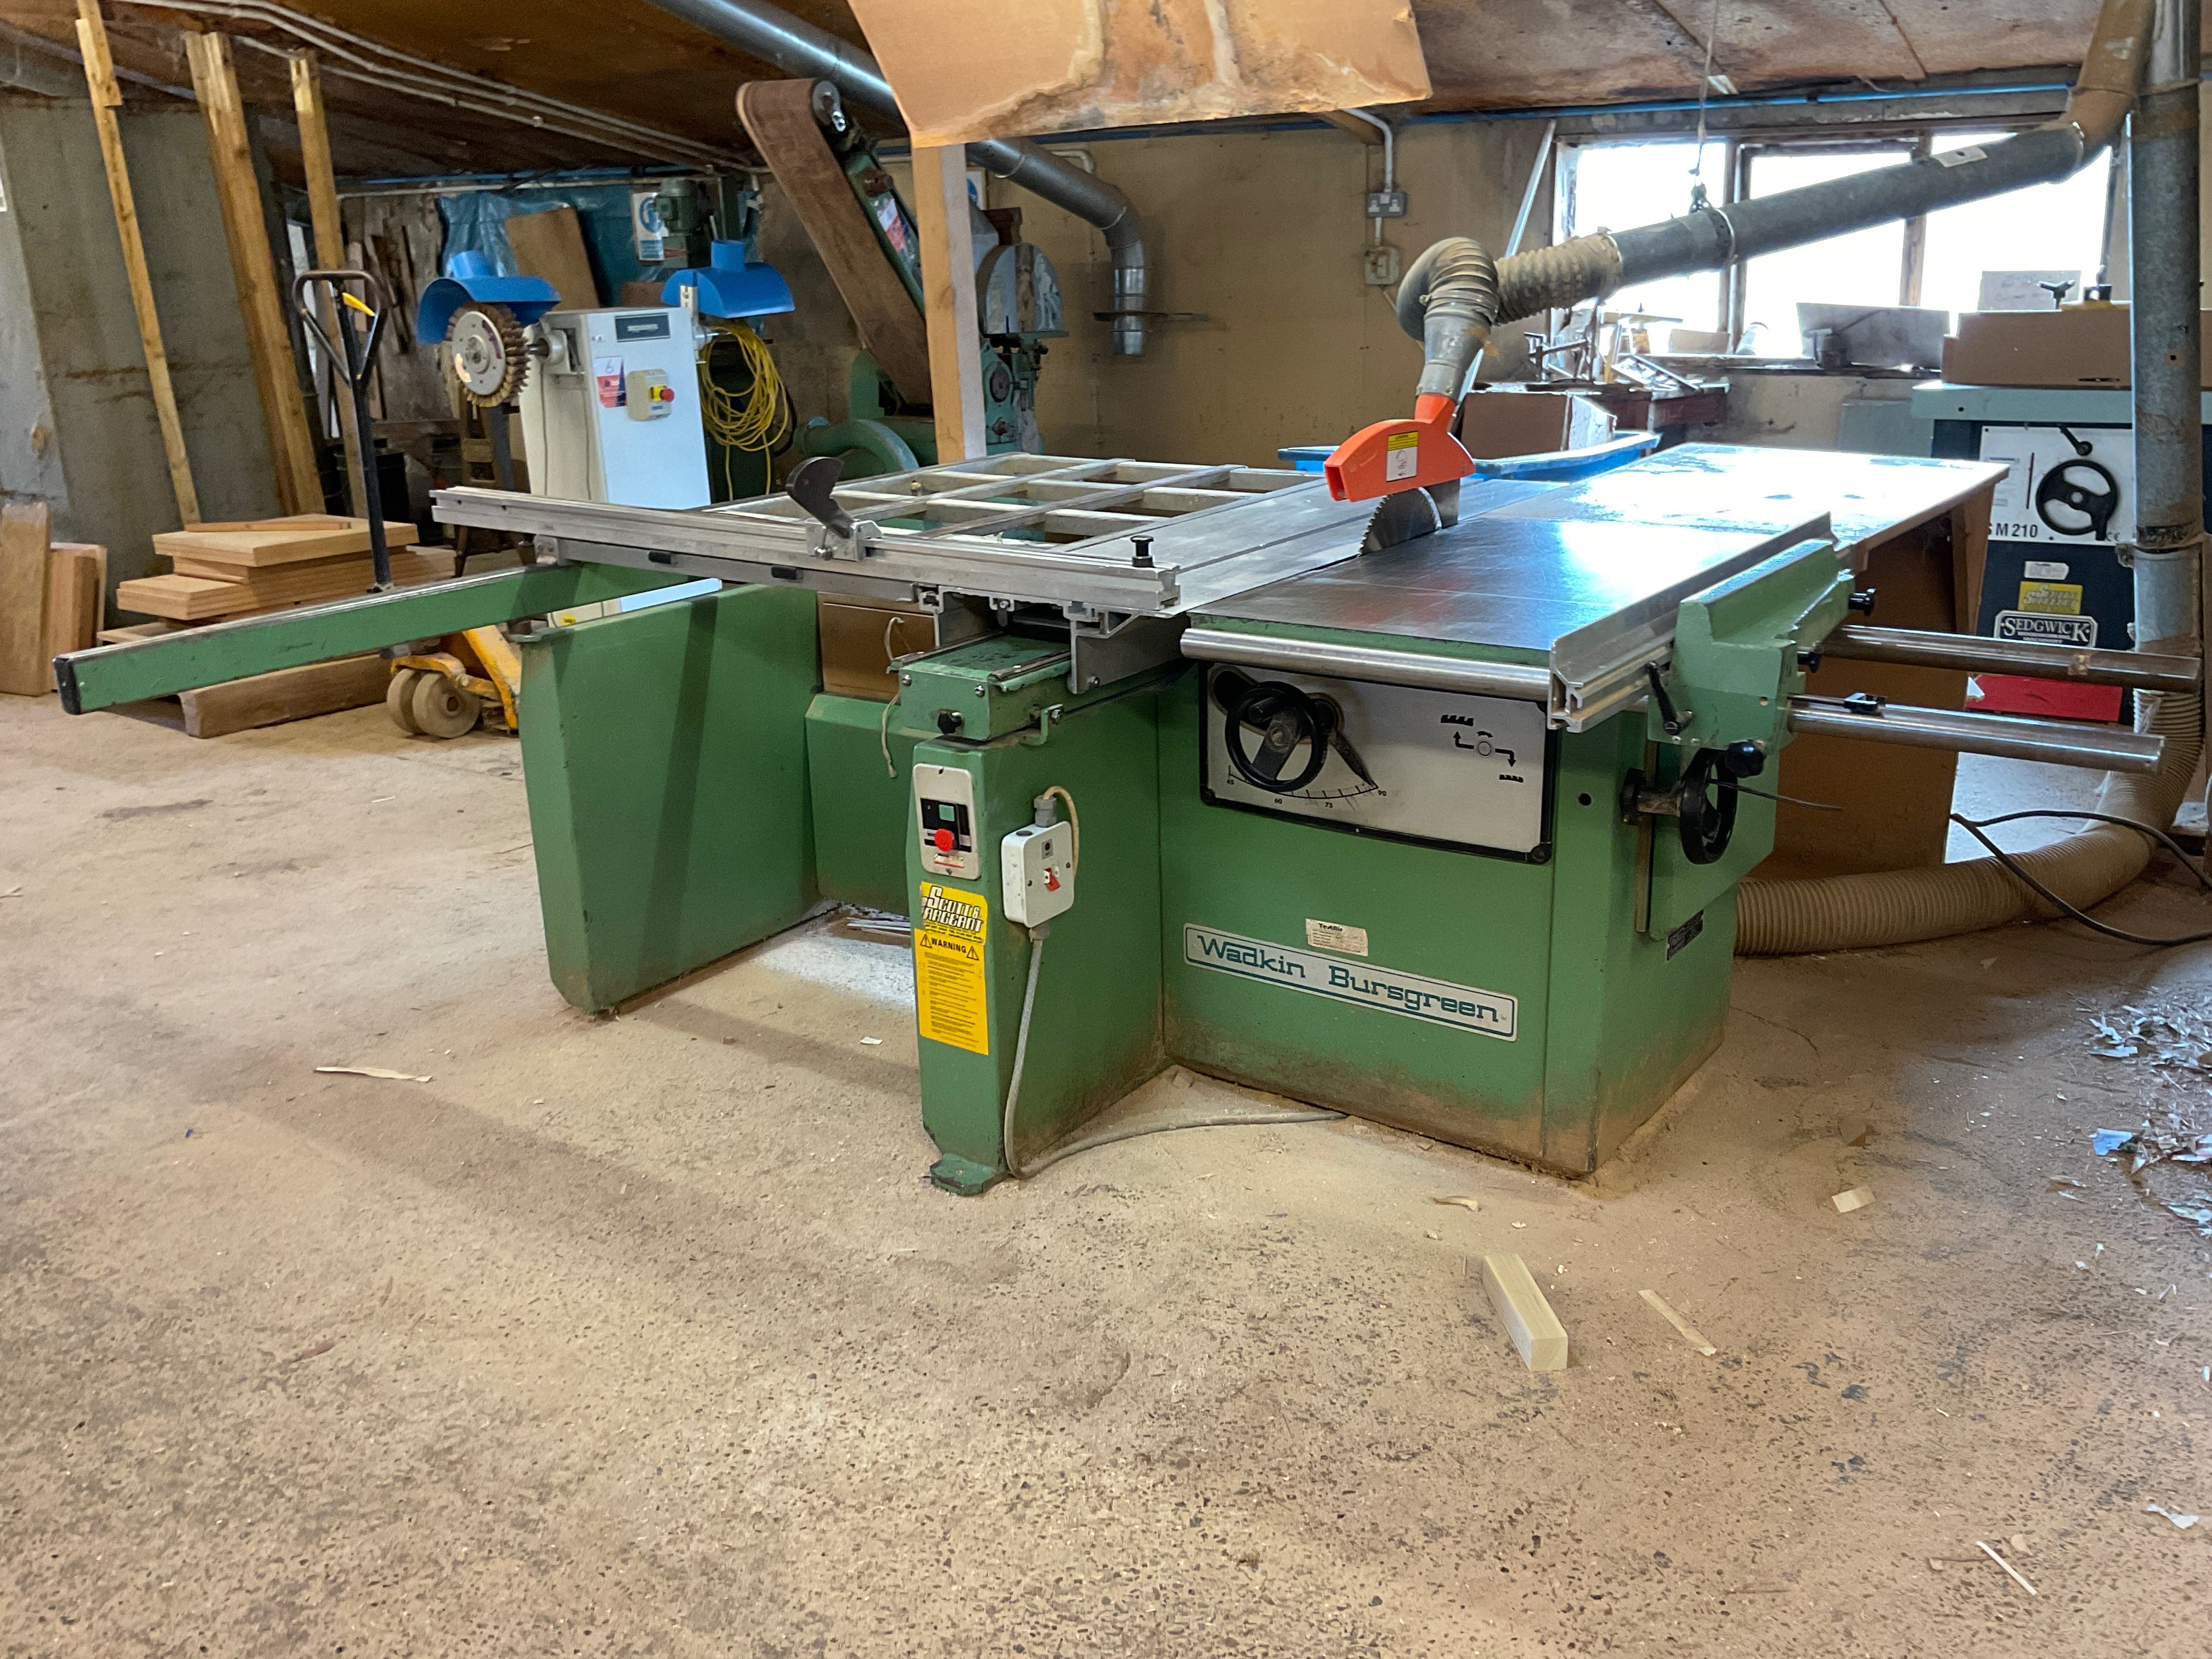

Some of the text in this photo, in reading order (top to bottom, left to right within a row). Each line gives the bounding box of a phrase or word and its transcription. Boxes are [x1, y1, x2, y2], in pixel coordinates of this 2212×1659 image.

[2012, 523, 2039, 538] 210
[2003, 618, 2089, 642] SEDGWICK
[926, 885, 973, 917] SCOTT
[931, 937, 967, 953] WARNING
[1198, 935, 1306, 979] Wadkin
[1328, 965, 1499, 1023] Bursgreen
